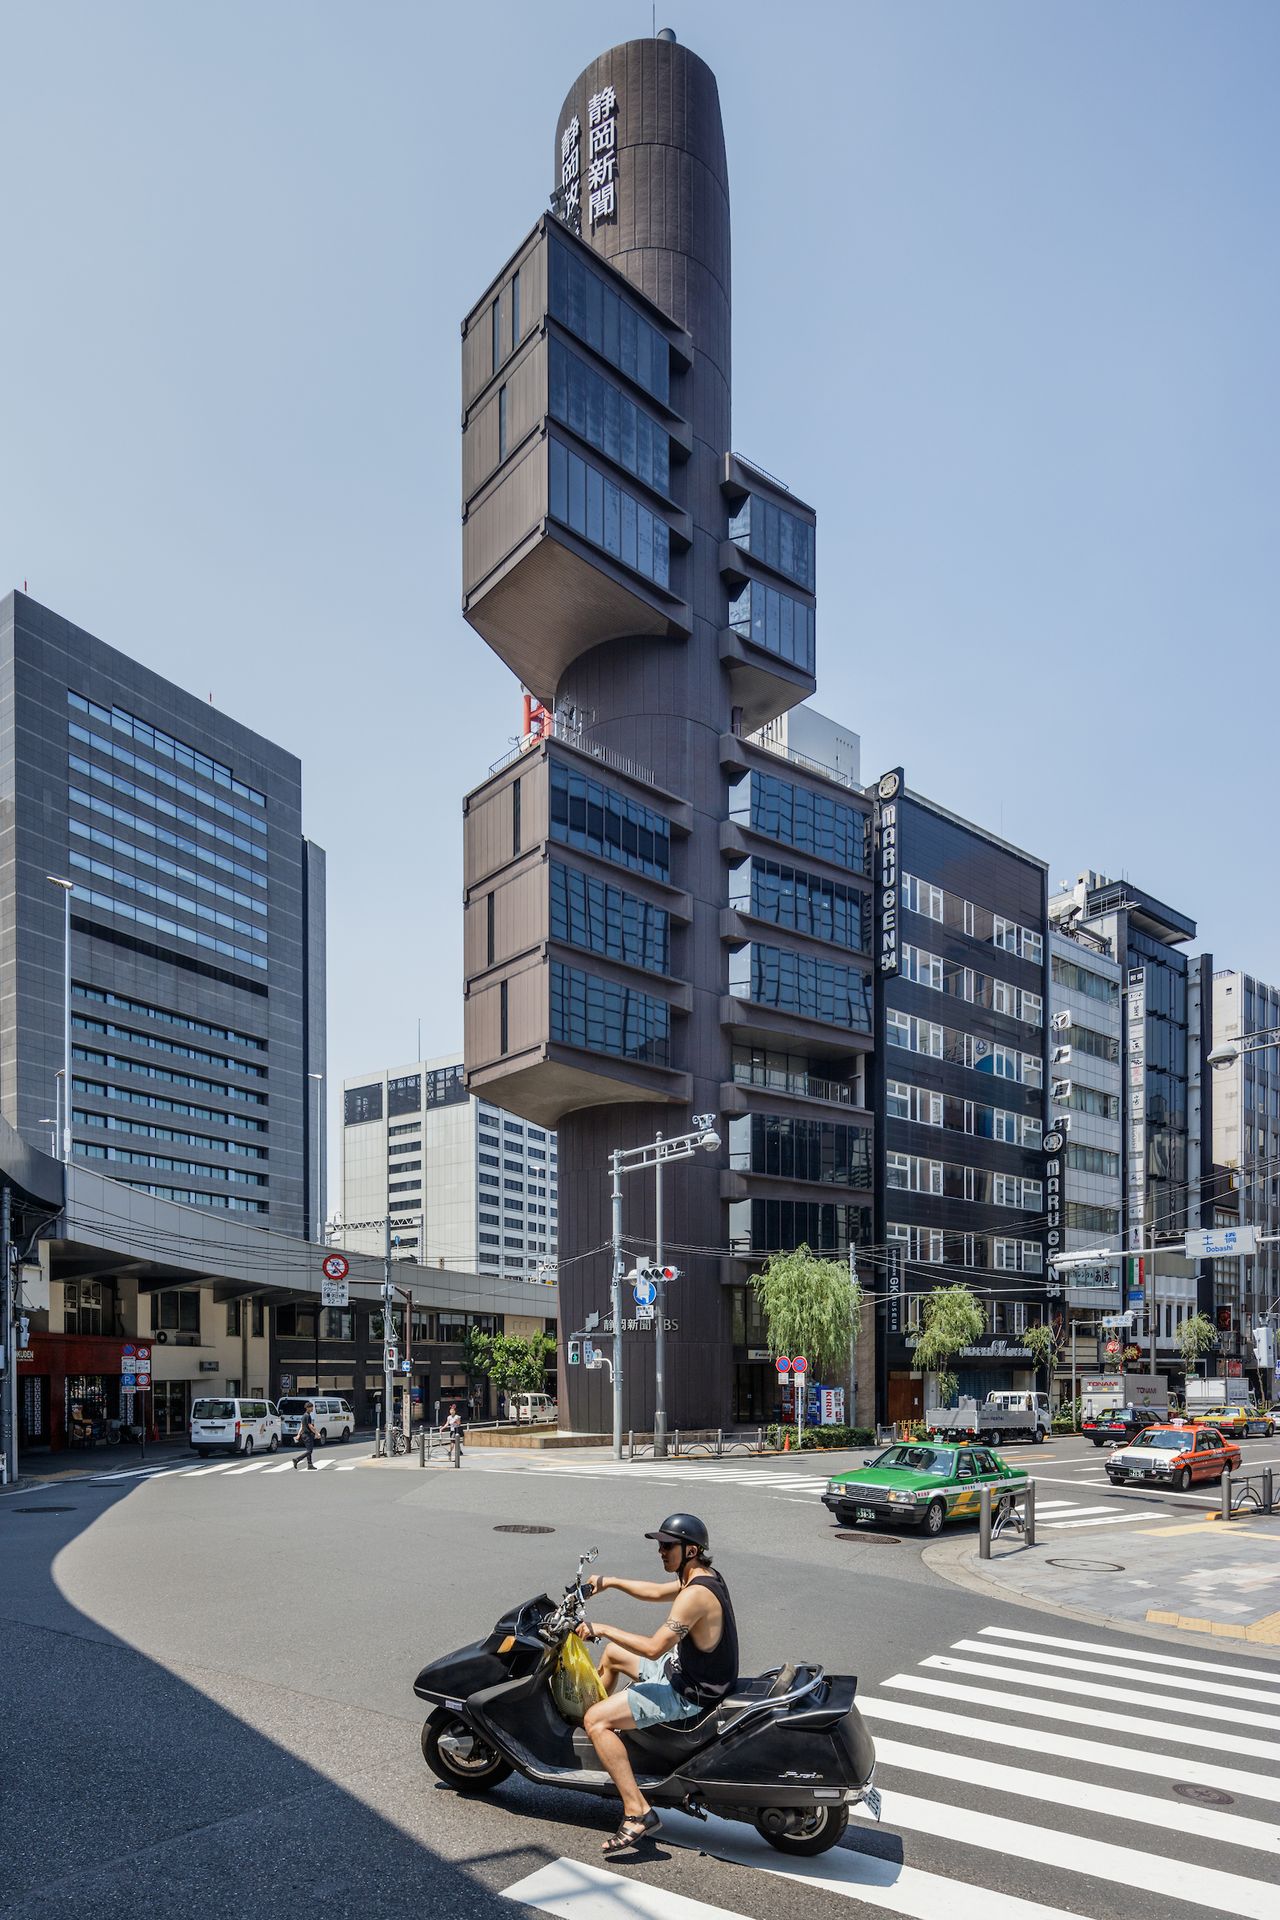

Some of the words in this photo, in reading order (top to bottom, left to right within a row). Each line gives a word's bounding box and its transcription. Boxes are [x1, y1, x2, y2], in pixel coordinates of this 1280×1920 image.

[588, 85, 617, 225] 静岡新聞
[881, 804, 896, 952] MARUGEN
[1206, 1244, 1233, 1253] Dobashi
[825, 1391, 833, 1418] KIRIN
